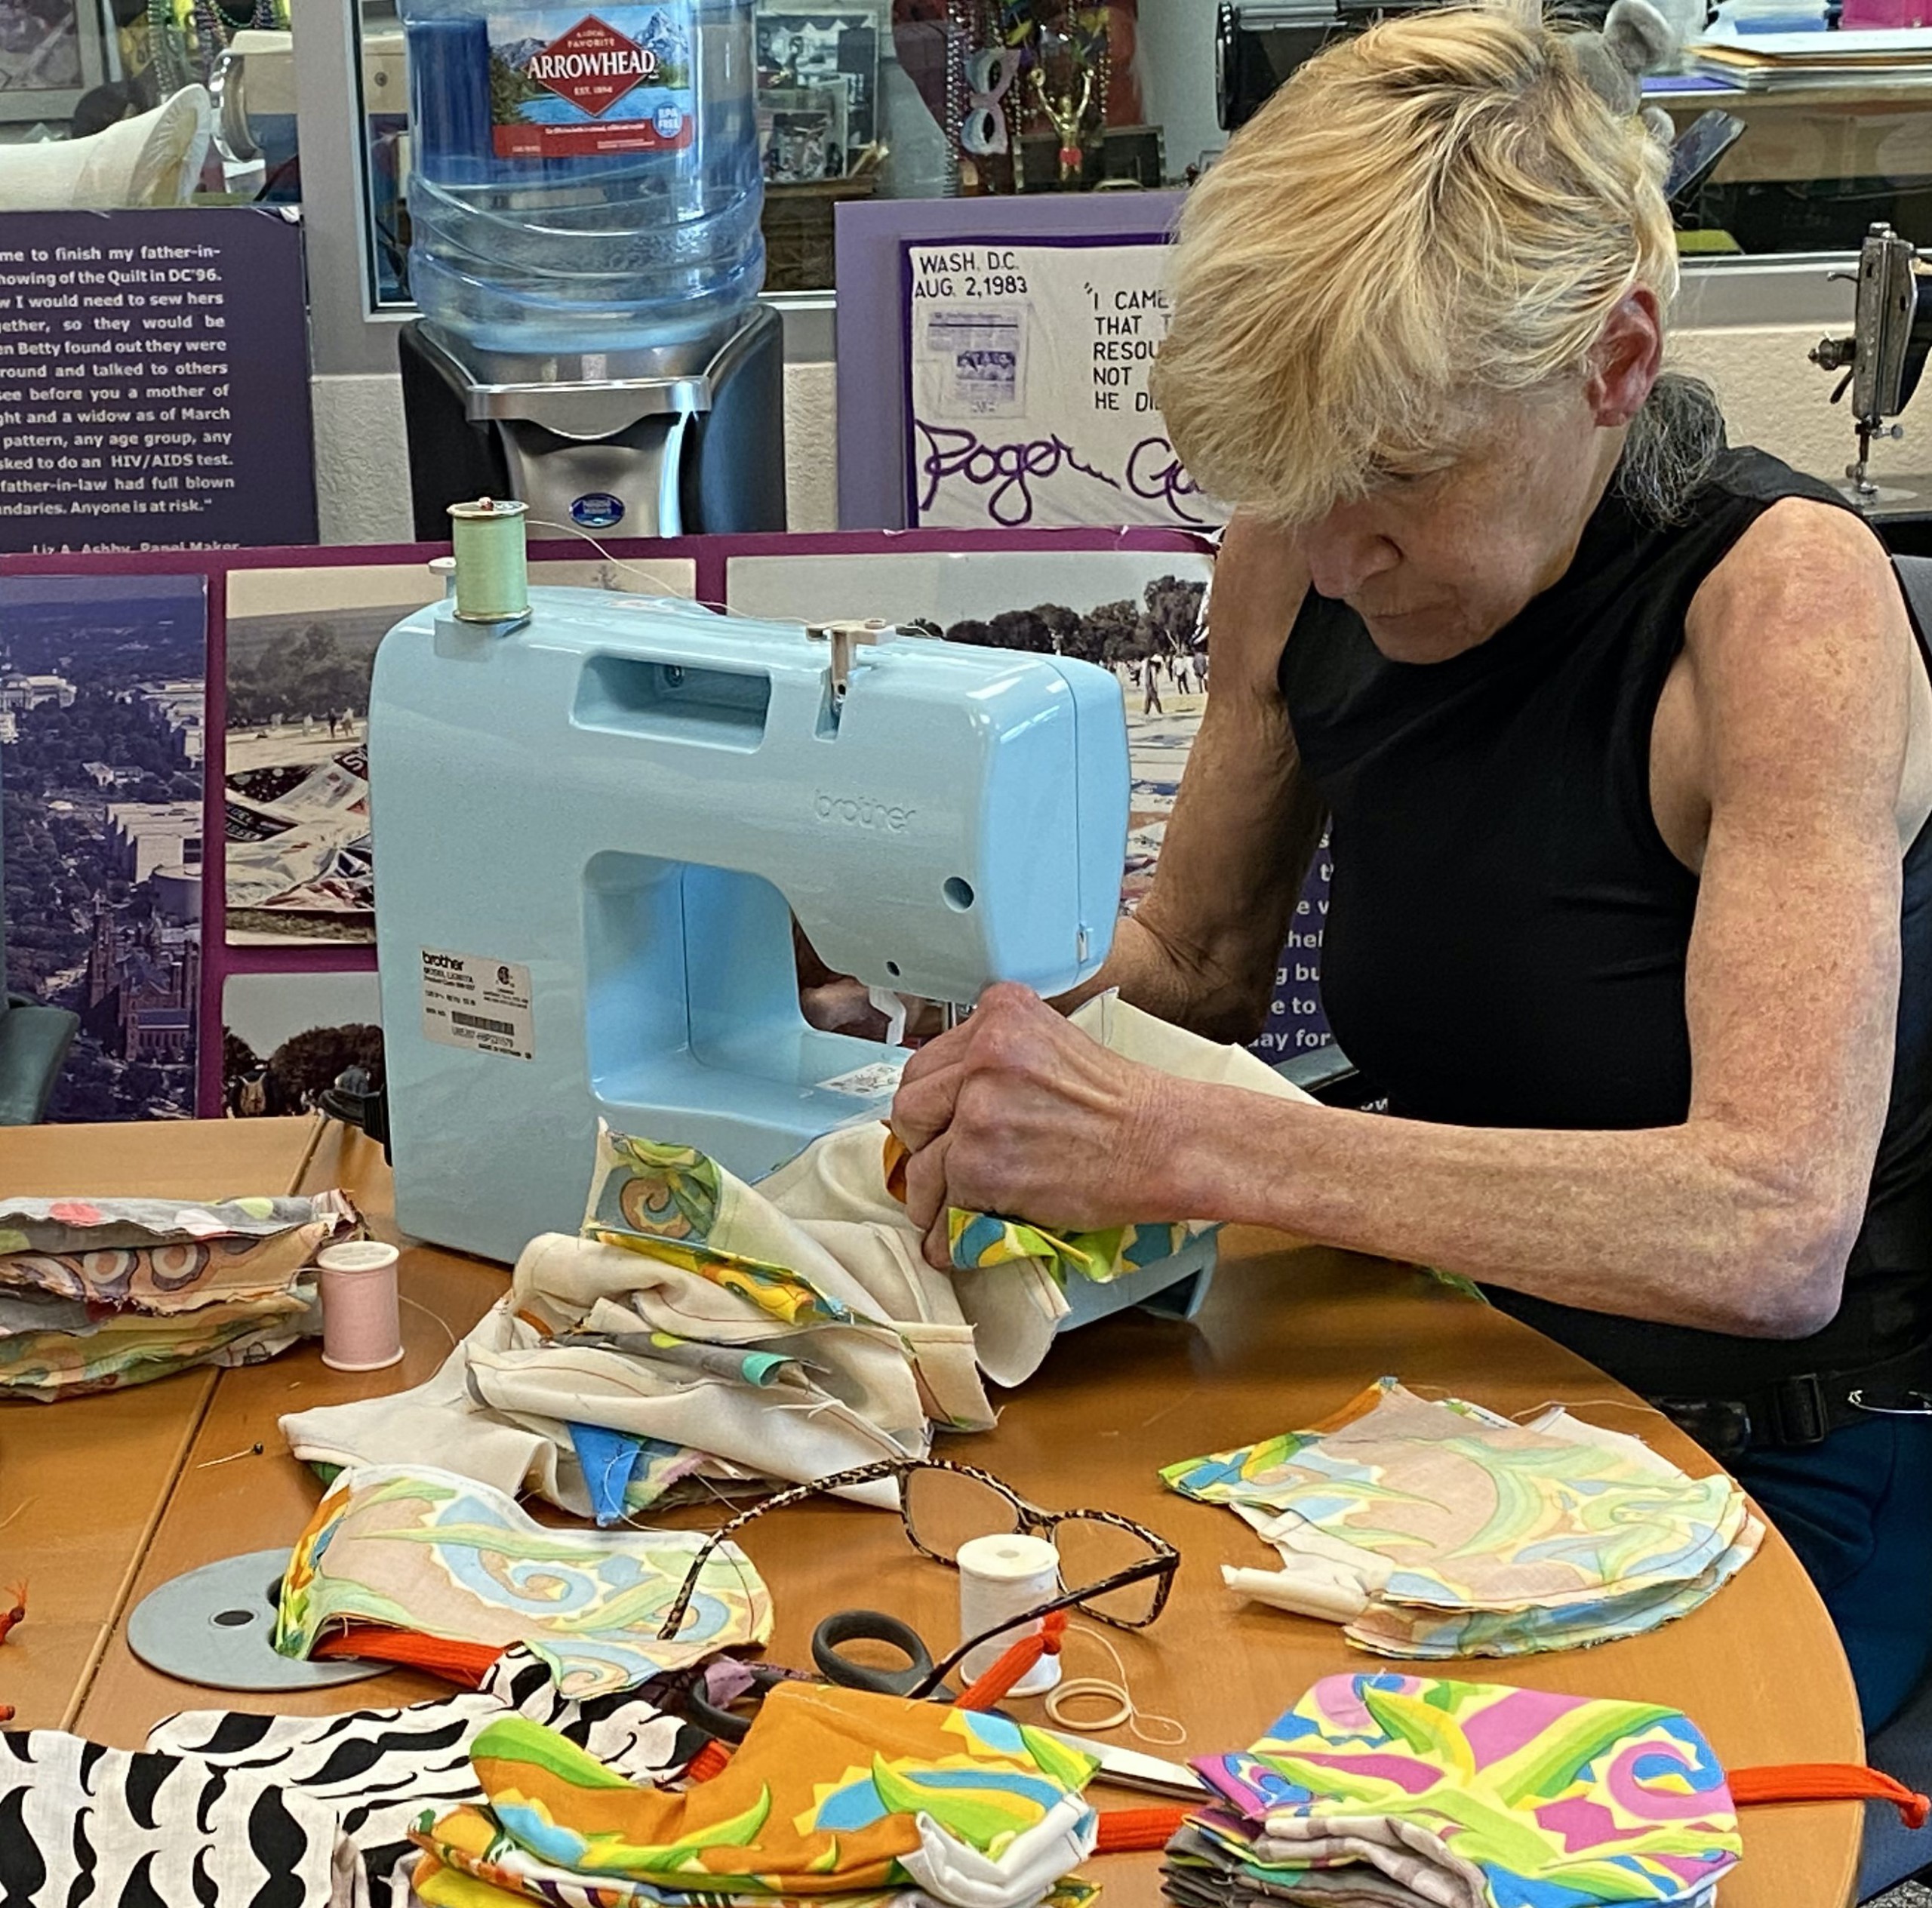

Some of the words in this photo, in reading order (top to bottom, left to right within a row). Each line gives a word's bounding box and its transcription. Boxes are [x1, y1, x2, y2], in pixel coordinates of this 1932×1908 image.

[568, 38, 615, 48] FAVORITE
[528, 50, 655, 79] ARROWHEAD
[31, 248, 49, 261] to
[55, 247, 101, 261] finish
[109, 248, 134, 262] my
[140, 245, 220, 259] father-in-
[59, 271, 75, 285] of
[78, 271, 105, 284] the
[108, 269, 147, 286] Quilt
[151, 269, 165, 282] in
[15, 295, 23, 308] I
[28, 294, 78, 308] would
[83, 294, 123, 306] need
[128, 294, 145, 306] to
[149, 294, 183, 306] sew
[187, 291, 223, 304] hers
[1115, 290, 1169, 310] CAME
[0, 319, 50, 334] ether,
[63, 320, 82, 331] so
[94, 317, 131, 333] they
[142, 315, 192, 328] would
[205, 315, 225, 328] be
[1094, 315, 1142, 336] THAT
[1161, 313, 1172, 334] T
[17, 342, 60, 357] Betty
[64, 340, 112, 354] found
[115, 340, 143, 352] out
[145, 340, 181, 355] they
[185, 340, 226, 351] were
[55, 364, 85, 377] and
[93, 362, 143, 376] talked
[150, 363, 168, 375] to
[175, 362, 229, 374] others
[1094, 367, 1133, 386] NOT
[29, 387, 82, 401] before
[90, 388, 120, 402] you
[128, 388, 138, 399] a
[146, 385, 205, 398] mother
[212, 383, 229, 397] of
[1095, 391, 1120, 411] HE
[1135, 392, 1160, 412] DI
[26, 411, 57, 423] and
[62, 412, 72, 423] a
[77, 409, 131, 423] widow
[136, 411, 155, 421] as
[159, 408, 177, 420] of
[181, 408, 231, 420] March
[3, 435, 69, 450] pattern,
[74, 434, 103, 448] any
[109, 433, 139, 448] age
[143, 432, 197, 447] group,
[202, 432, 232, 445] any
[37, 457, 54, 469] to
[57, 456, 78, 469] do
[82, 457, 102, 468] an
[111, 454, 194, 469] HIV/AIDS
[196, 454, 234, 466] test.
[914, 419, 1121, 527] Roger
[0, 478, 108, 492] father-in-law
[115, 477, 144, 490] had
[152, 476, 179, 490] full
[185, 476, 235, 489] blown
[0, 502, 66, 515] ndaries.
[70, 500, 131, 516] Anyone
[133, 500, 146, 512] is
[149, 500, 166, 512] at
[815, 787, 916, 833] brother
[422, 950, 464, 971] brother
[1292, 997, 1316, 1014] to
[1296, 1029, 1331, 1048] for
